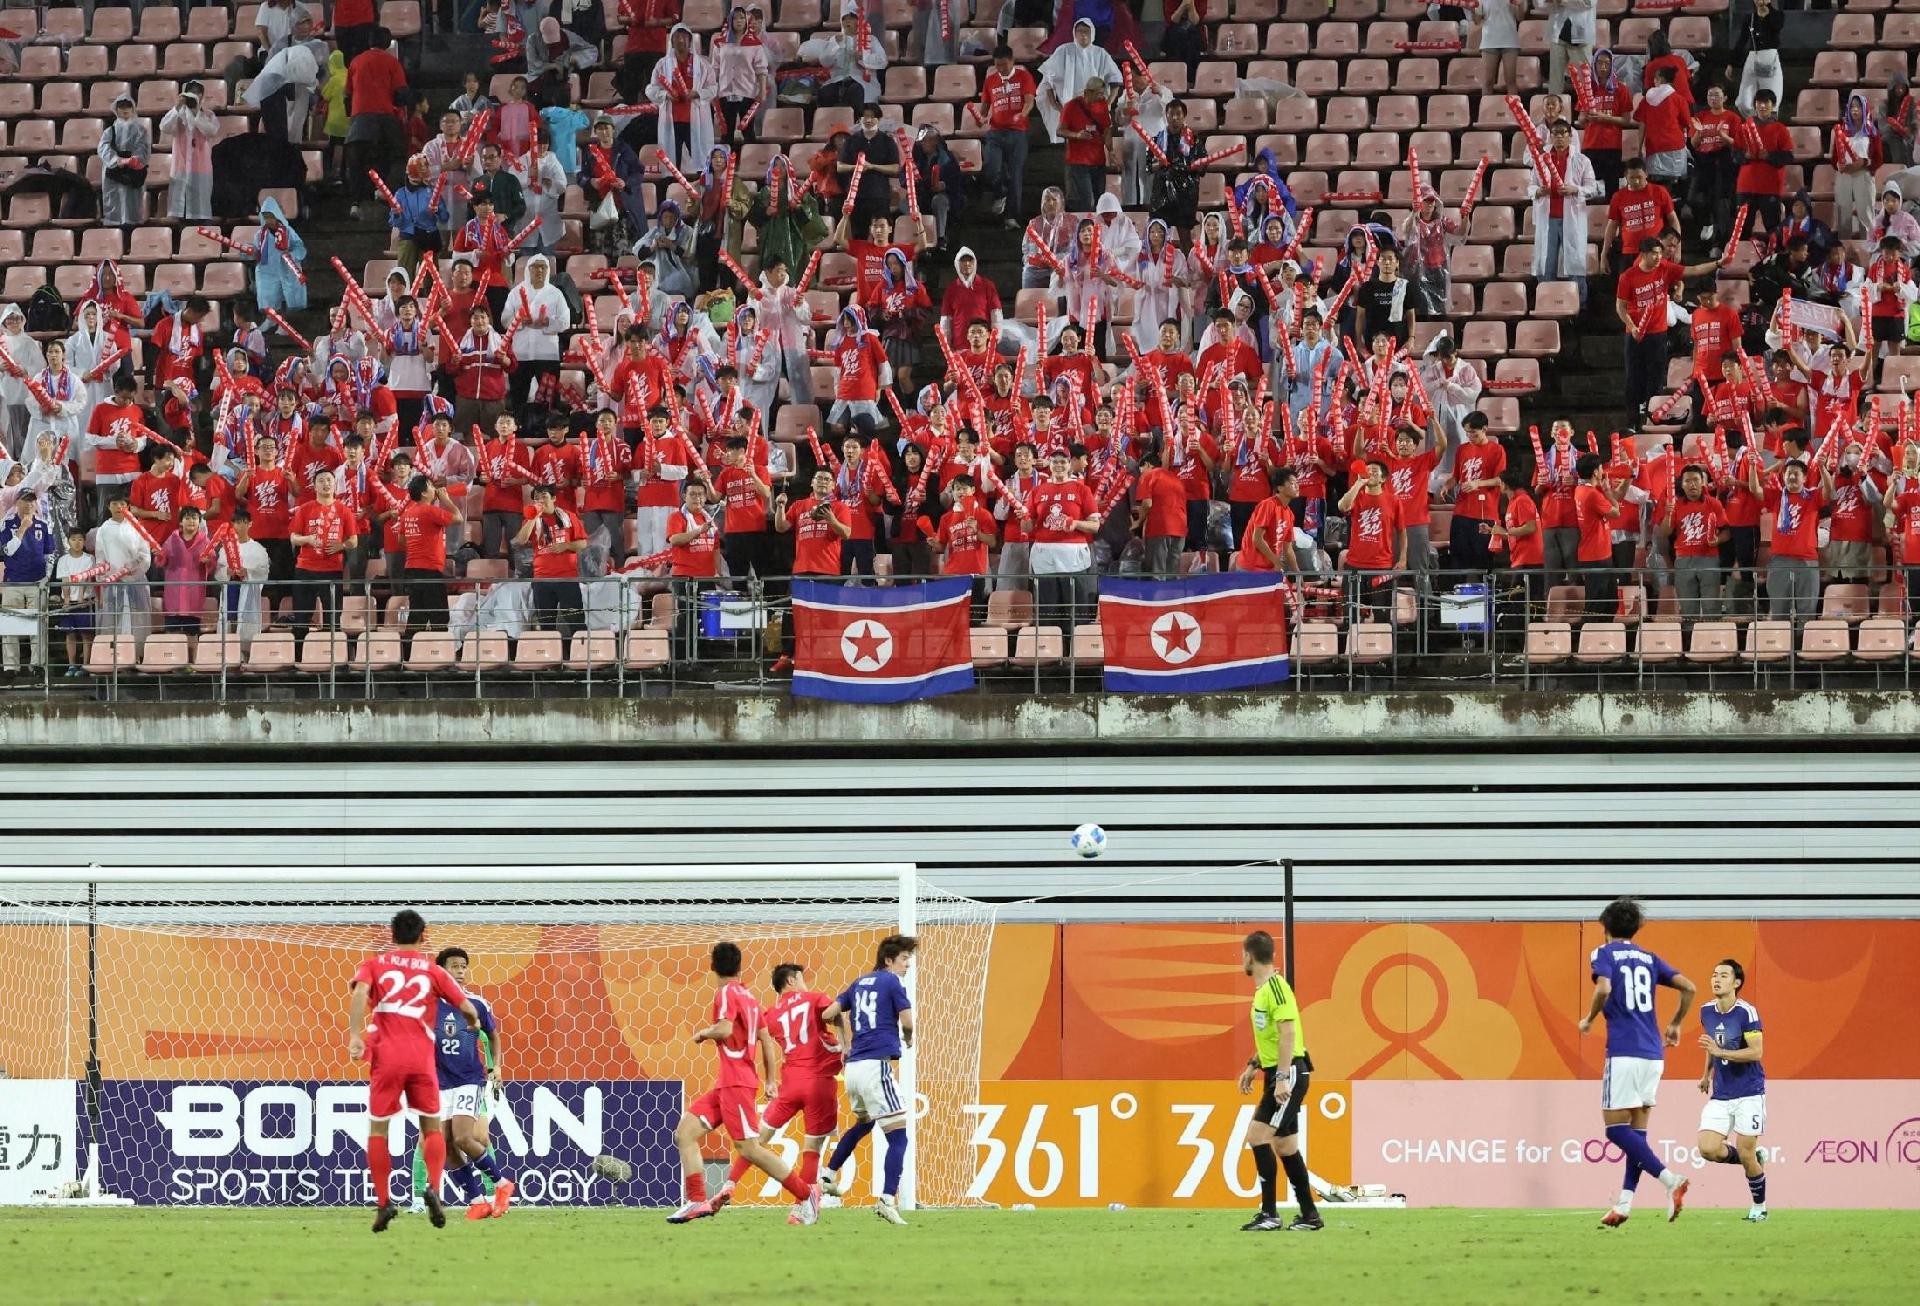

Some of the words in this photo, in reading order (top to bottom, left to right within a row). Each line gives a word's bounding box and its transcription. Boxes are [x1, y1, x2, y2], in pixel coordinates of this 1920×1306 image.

[373, 969, 432, 1020] 22
[1620, 965, 1654, 1013] 18
[777, 1001, 810, 1054] 17
[854, 989, 878, 1032] 14
[441, 1038, 461, 1056] 22
[456, 1093, 475, 1111] 22
[1751, 1114, 1760, 1130] 5
[0, 1124, 62, 1171] 力
[1380, 1138, 1507, 1164] CHANGE
[1515, 1138, 1553, 1164] for
[171, 1168, 320, 1201] SPORTS
